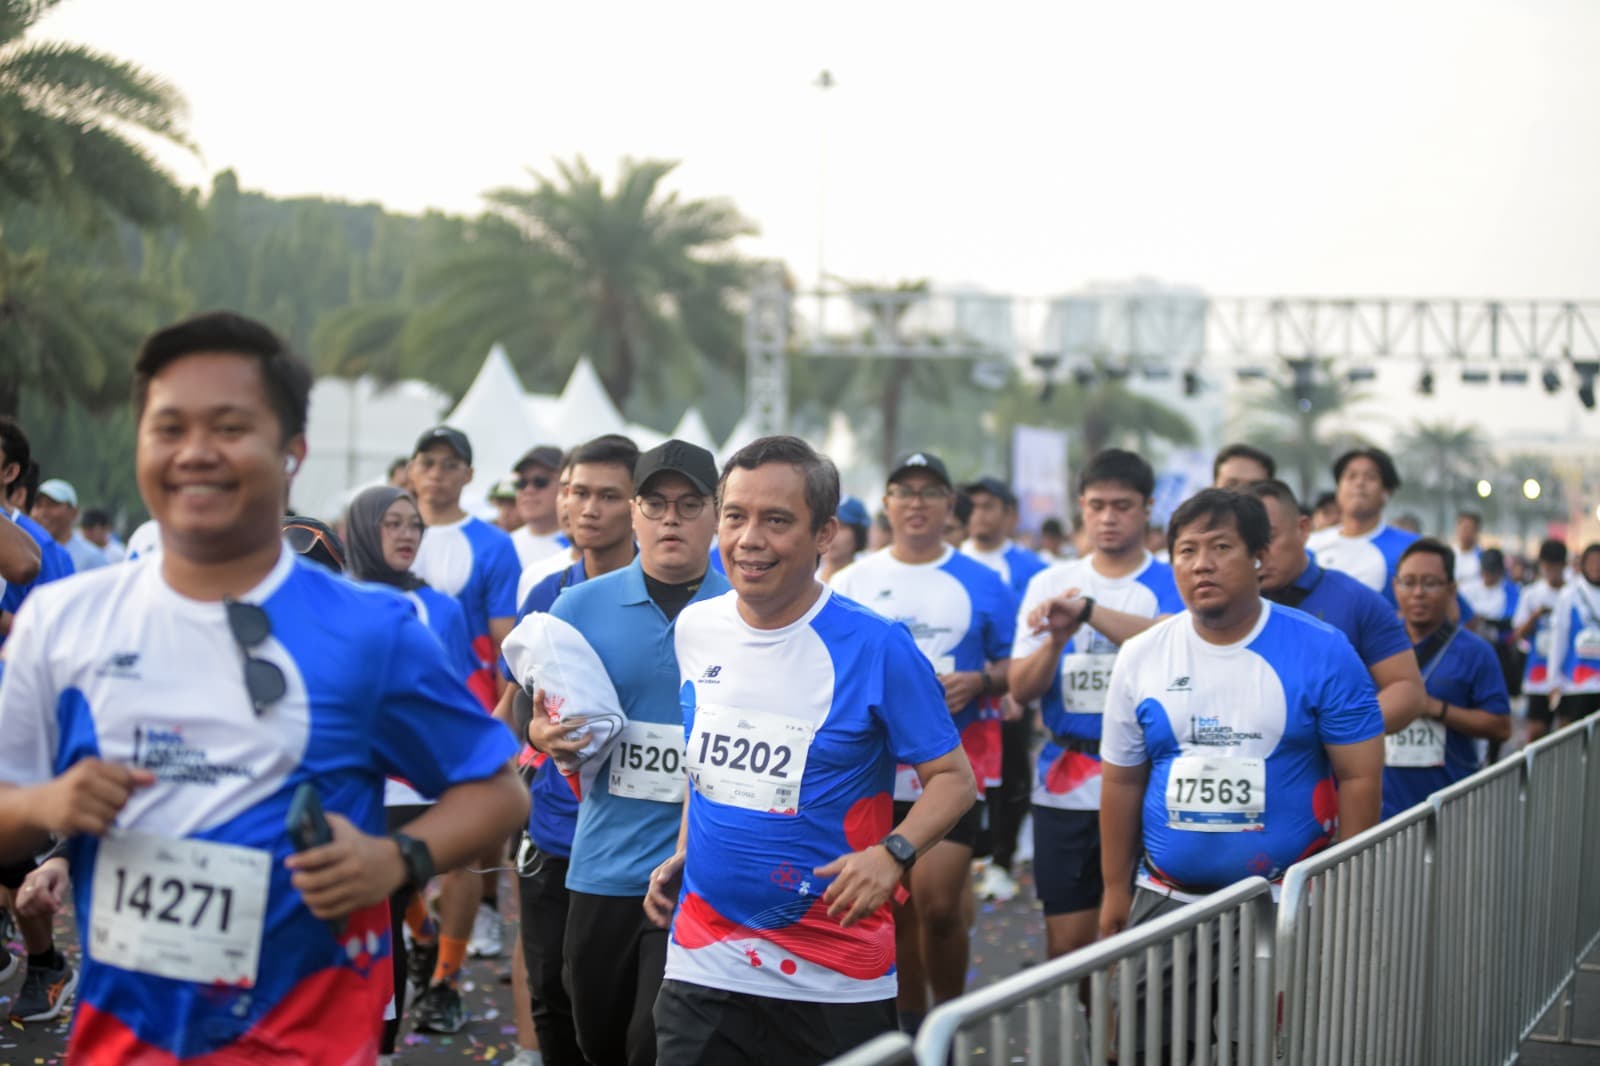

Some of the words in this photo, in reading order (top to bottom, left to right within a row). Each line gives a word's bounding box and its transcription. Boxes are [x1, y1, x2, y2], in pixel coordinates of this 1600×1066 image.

[699, 731, 792, 779] 15202
[1176, 778, 1251, 805] 17563
[114, 867, 233, 934] 14271
